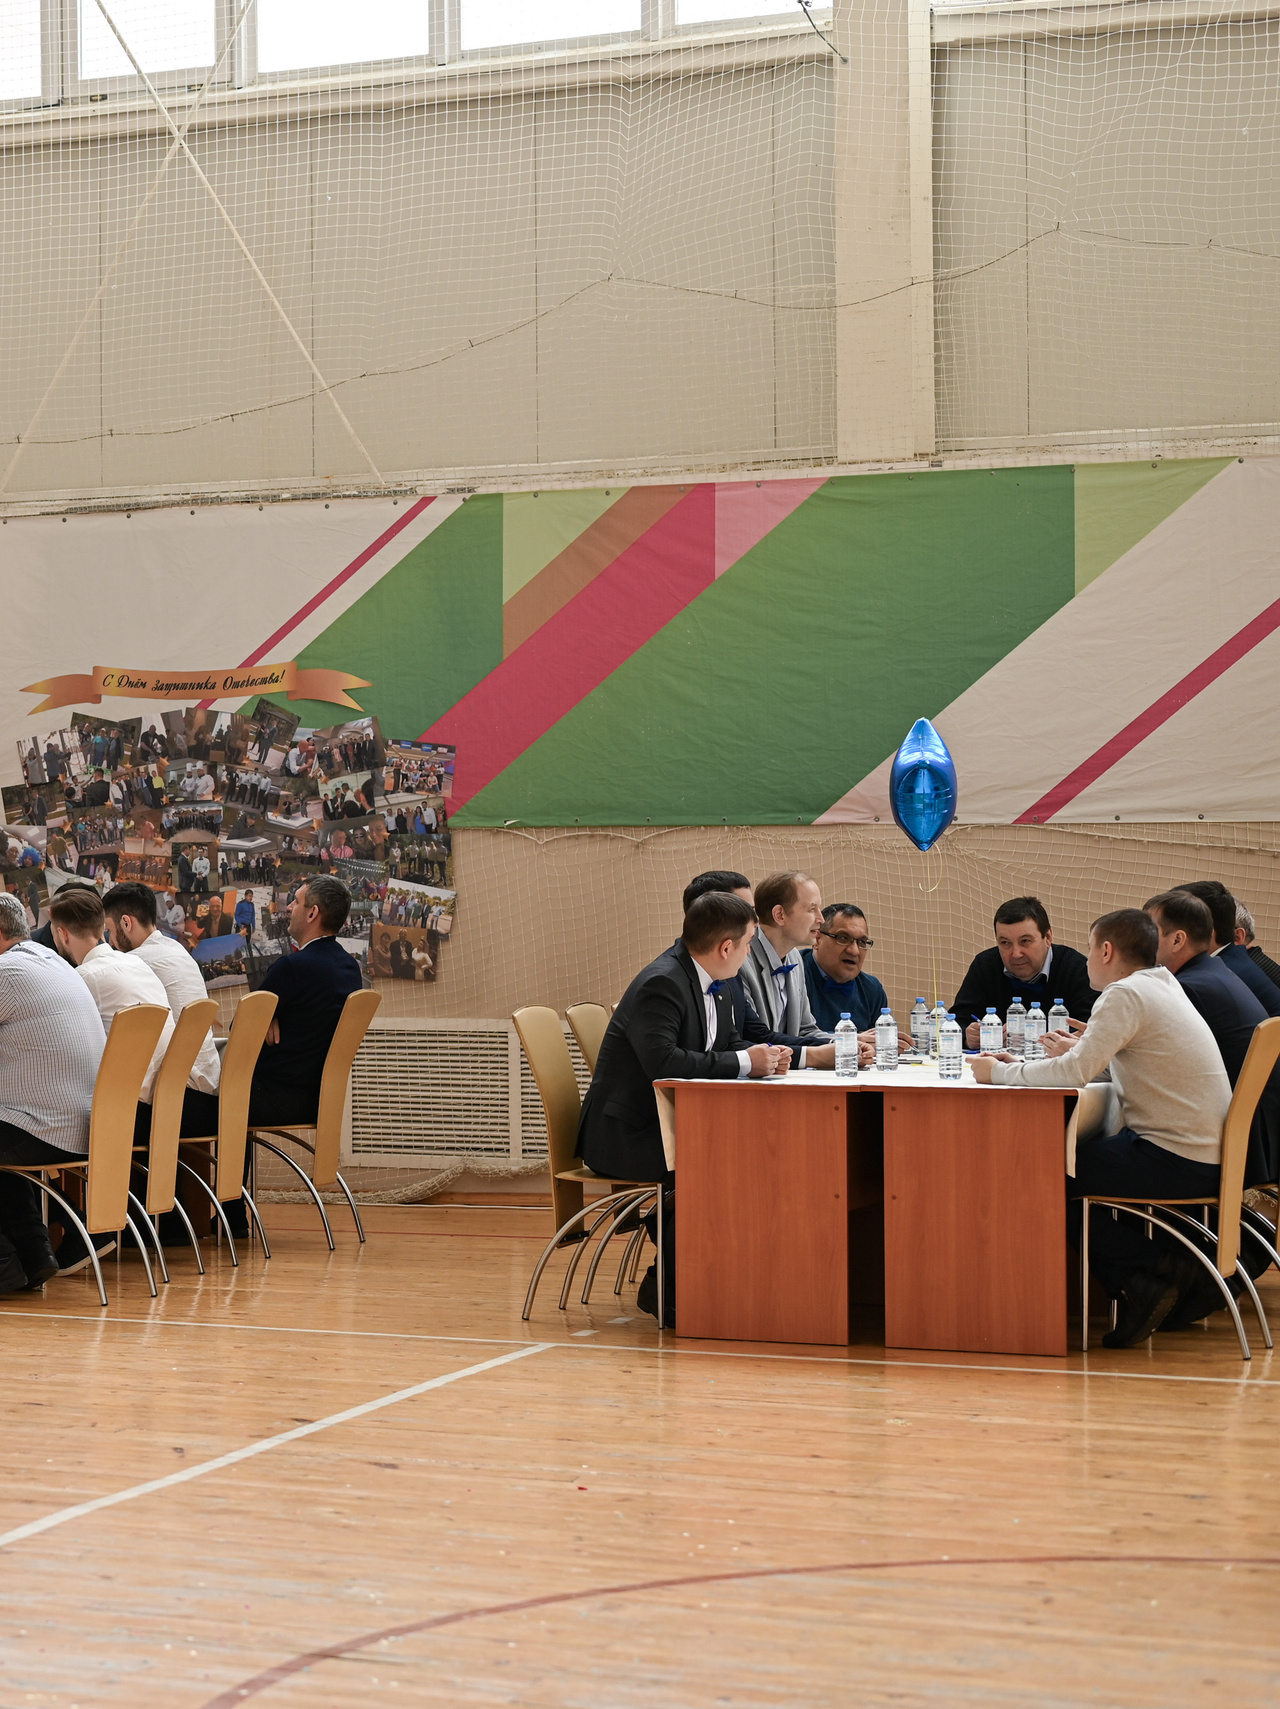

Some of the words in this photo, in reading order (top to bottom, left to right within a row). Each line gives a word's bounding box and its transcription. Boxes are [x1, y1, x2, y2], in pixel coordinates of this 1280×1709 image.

[102, 674, 114, 687] С
[116, 674, 147, 688] Днём
[151, 676, 216, 696] Защитника
[223, 670, 286, 690] Отечества!
